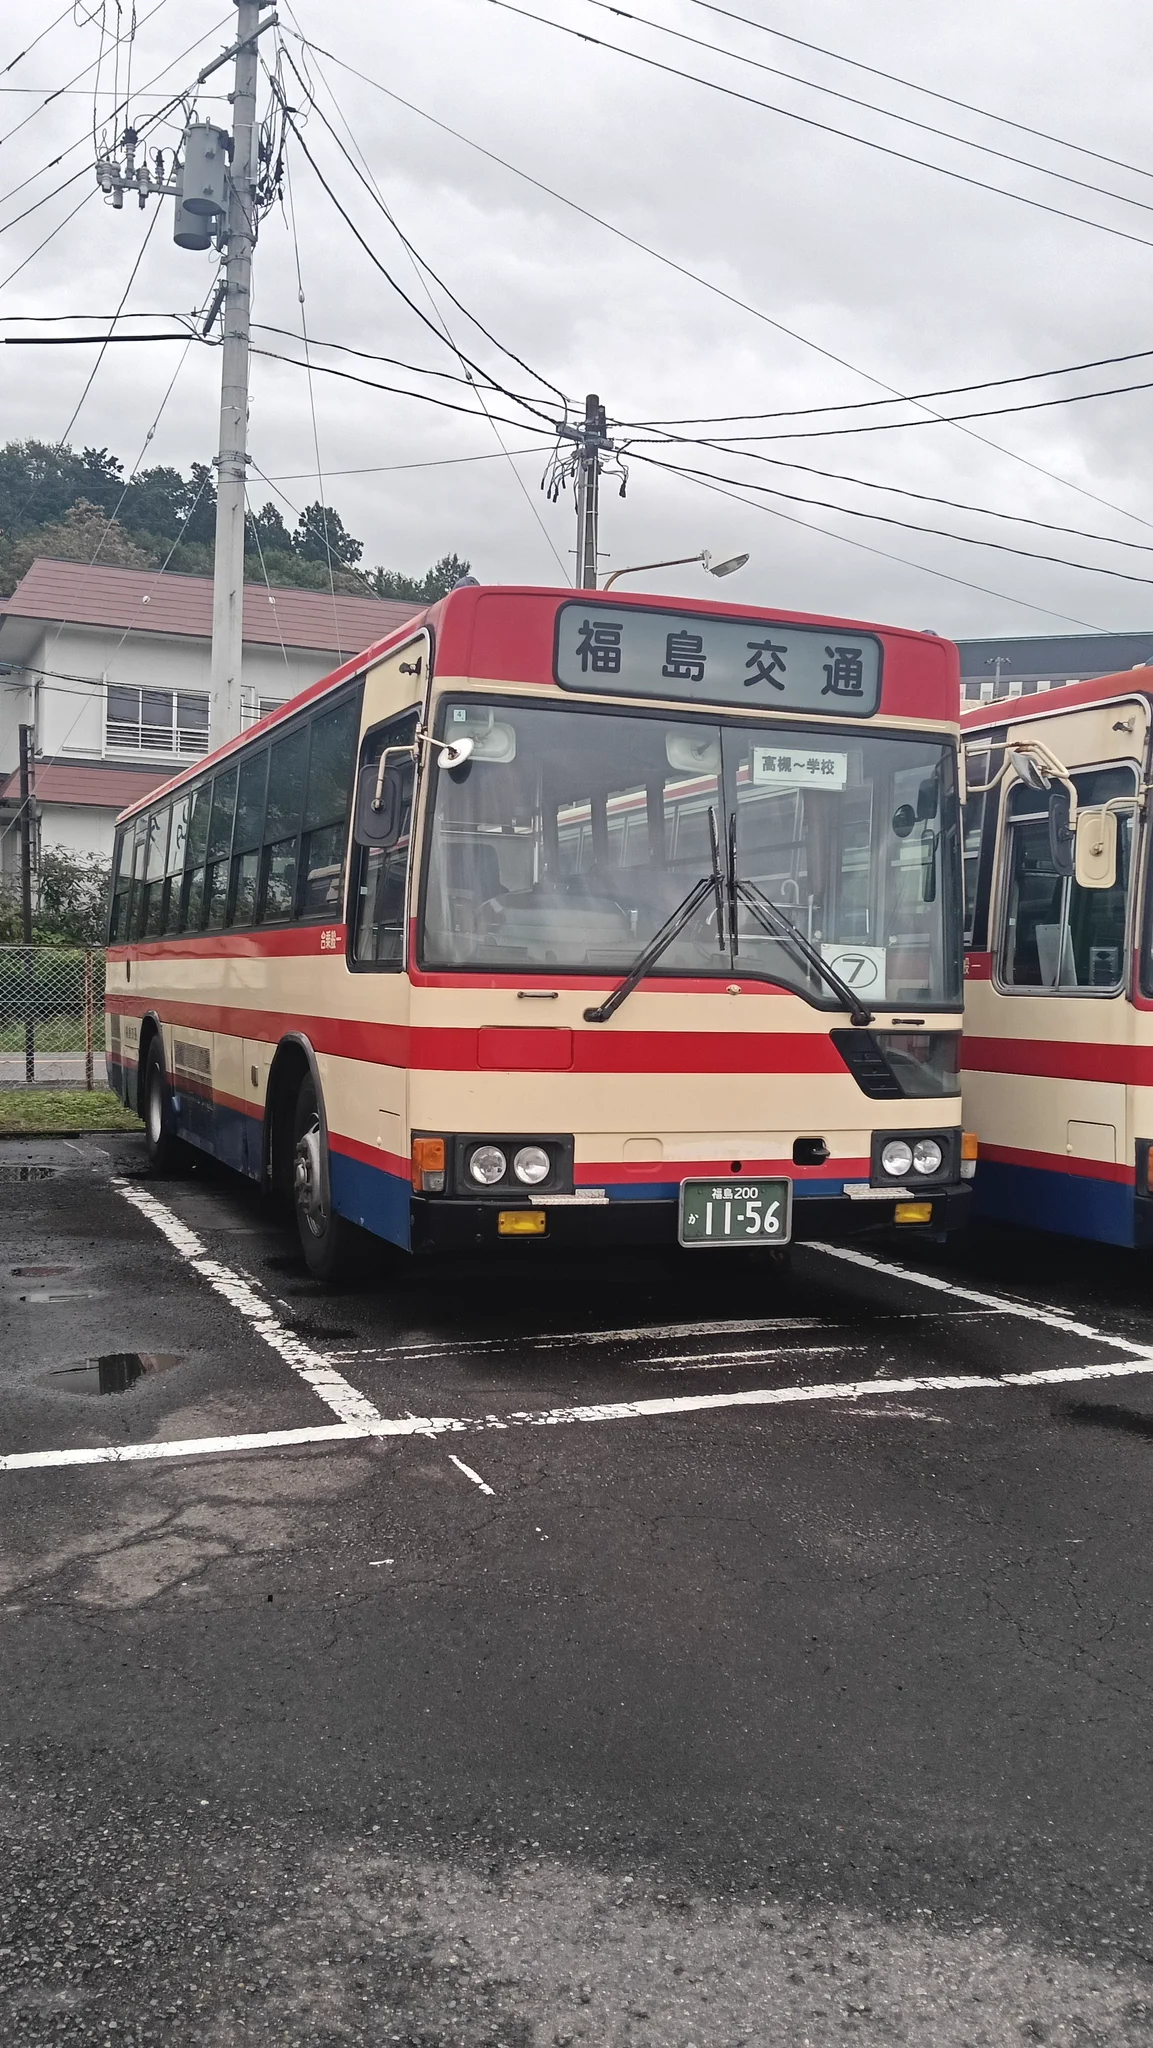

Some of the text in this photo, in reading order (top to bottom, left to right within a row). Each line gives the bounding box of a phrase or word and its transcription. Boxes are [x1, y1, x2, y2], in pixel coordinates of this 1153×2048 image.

[575, 619, 865, 698] 福島交通
[705, 1200, 780, 1235] 11-56
